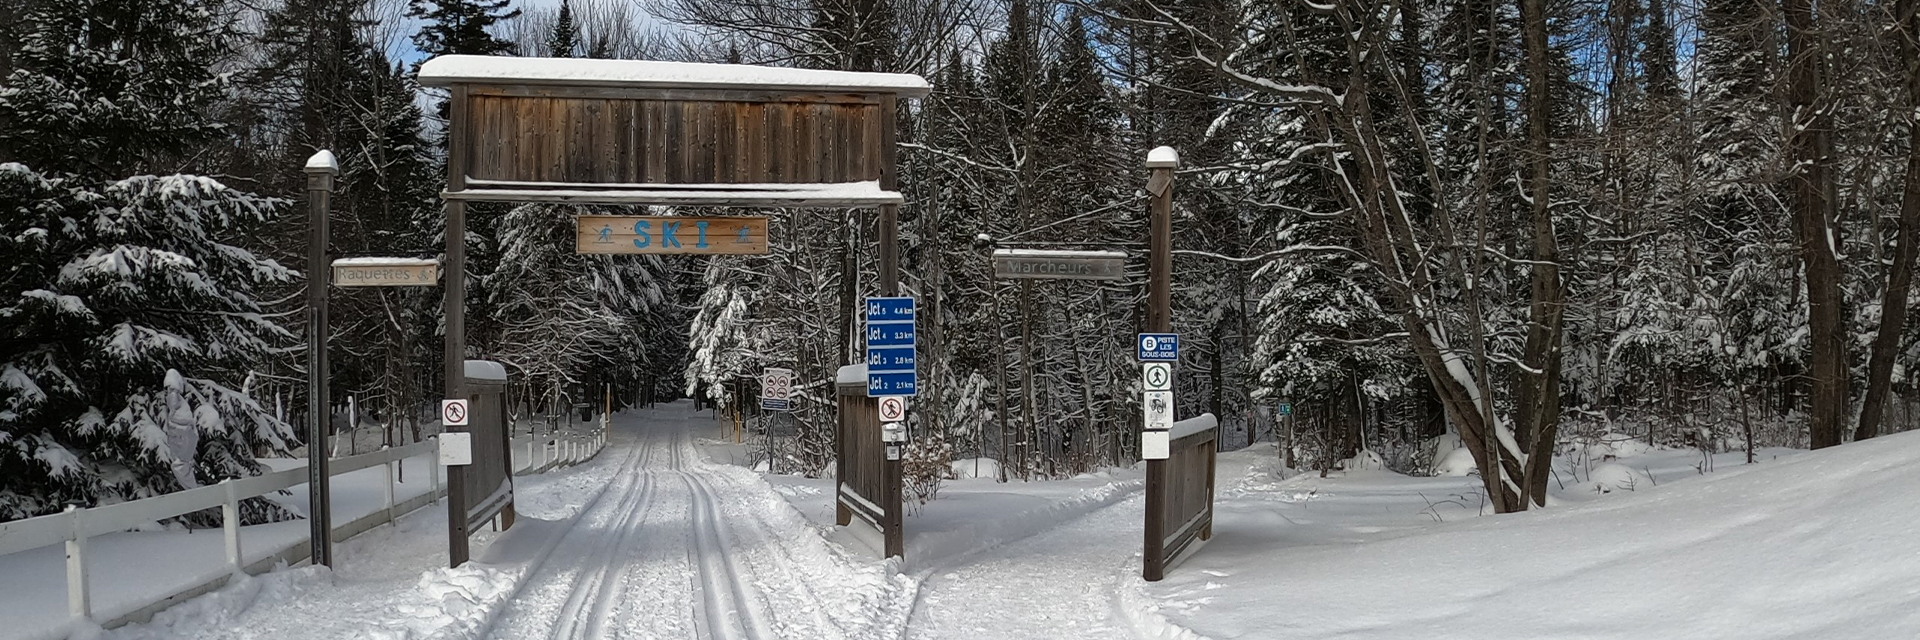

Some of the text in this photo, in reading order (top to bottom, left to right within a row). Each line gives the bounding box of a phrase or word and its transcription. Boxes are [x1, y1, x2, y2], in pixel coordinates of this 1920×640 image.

[634, 221, 709, 248] SKI
[1007, 261, 1091, 274] Marcheurs
[339, 267, 410, 283] Raquettes
[869, 302, 880, 315] Jct
[869, 327, 880, 340] Jct
[1146, 340, 1154, 348] B
[869, 352, 881, 365] Jct
[870, 377, 882, 390] Jct
